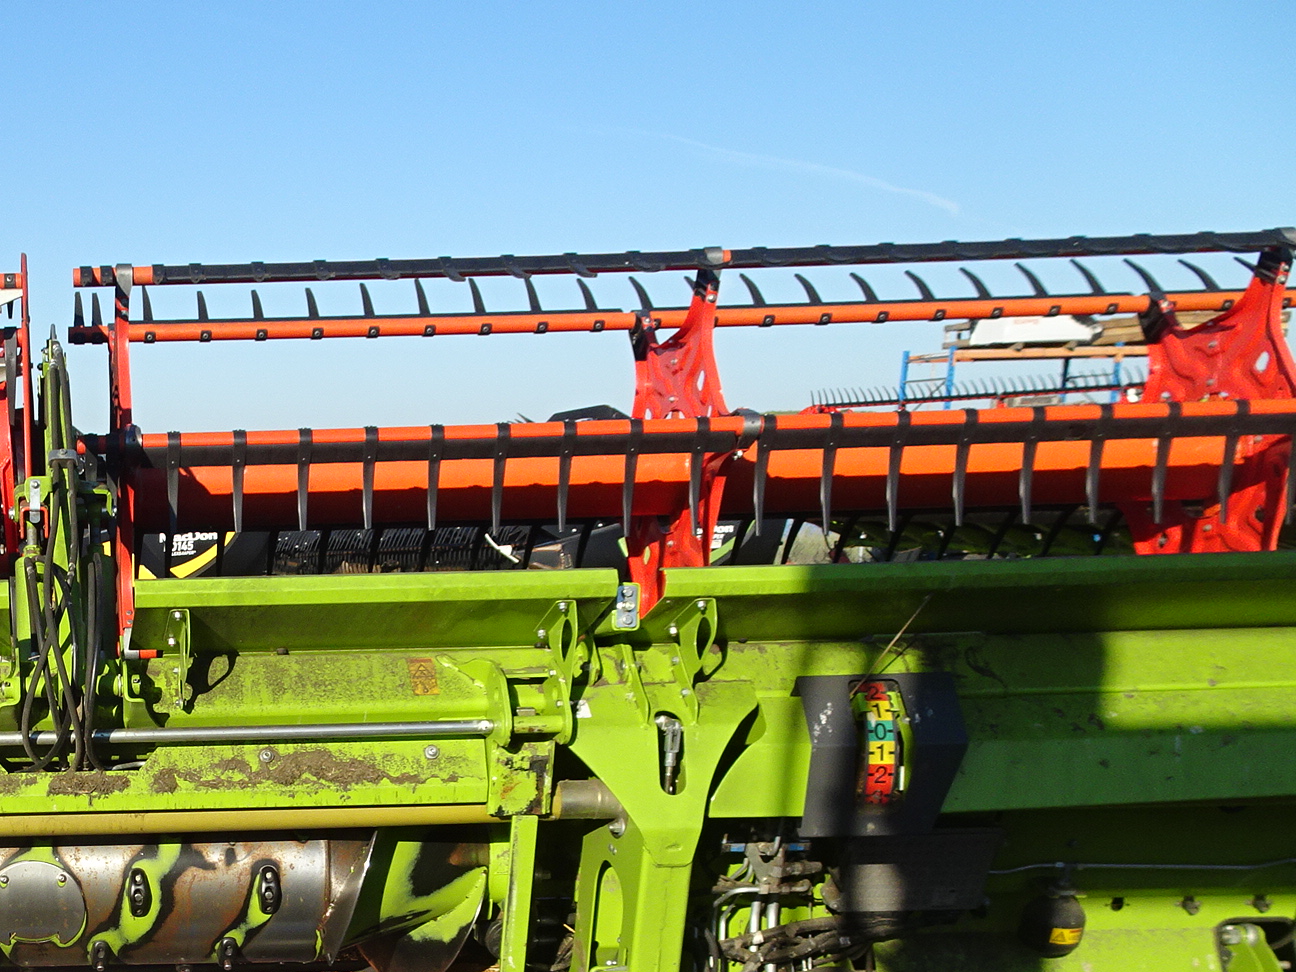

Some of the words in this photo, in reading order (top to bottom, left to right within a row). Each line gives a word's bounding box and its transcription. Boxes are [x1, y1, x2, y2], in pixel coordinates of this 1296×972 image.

[869, 686, 880, 700] 2
[872, 703, 882, 718] 1
[874, 722, 887, 740] 0
[876, 744, 884, 761] 1
[874, 765, 887, 784] 2
